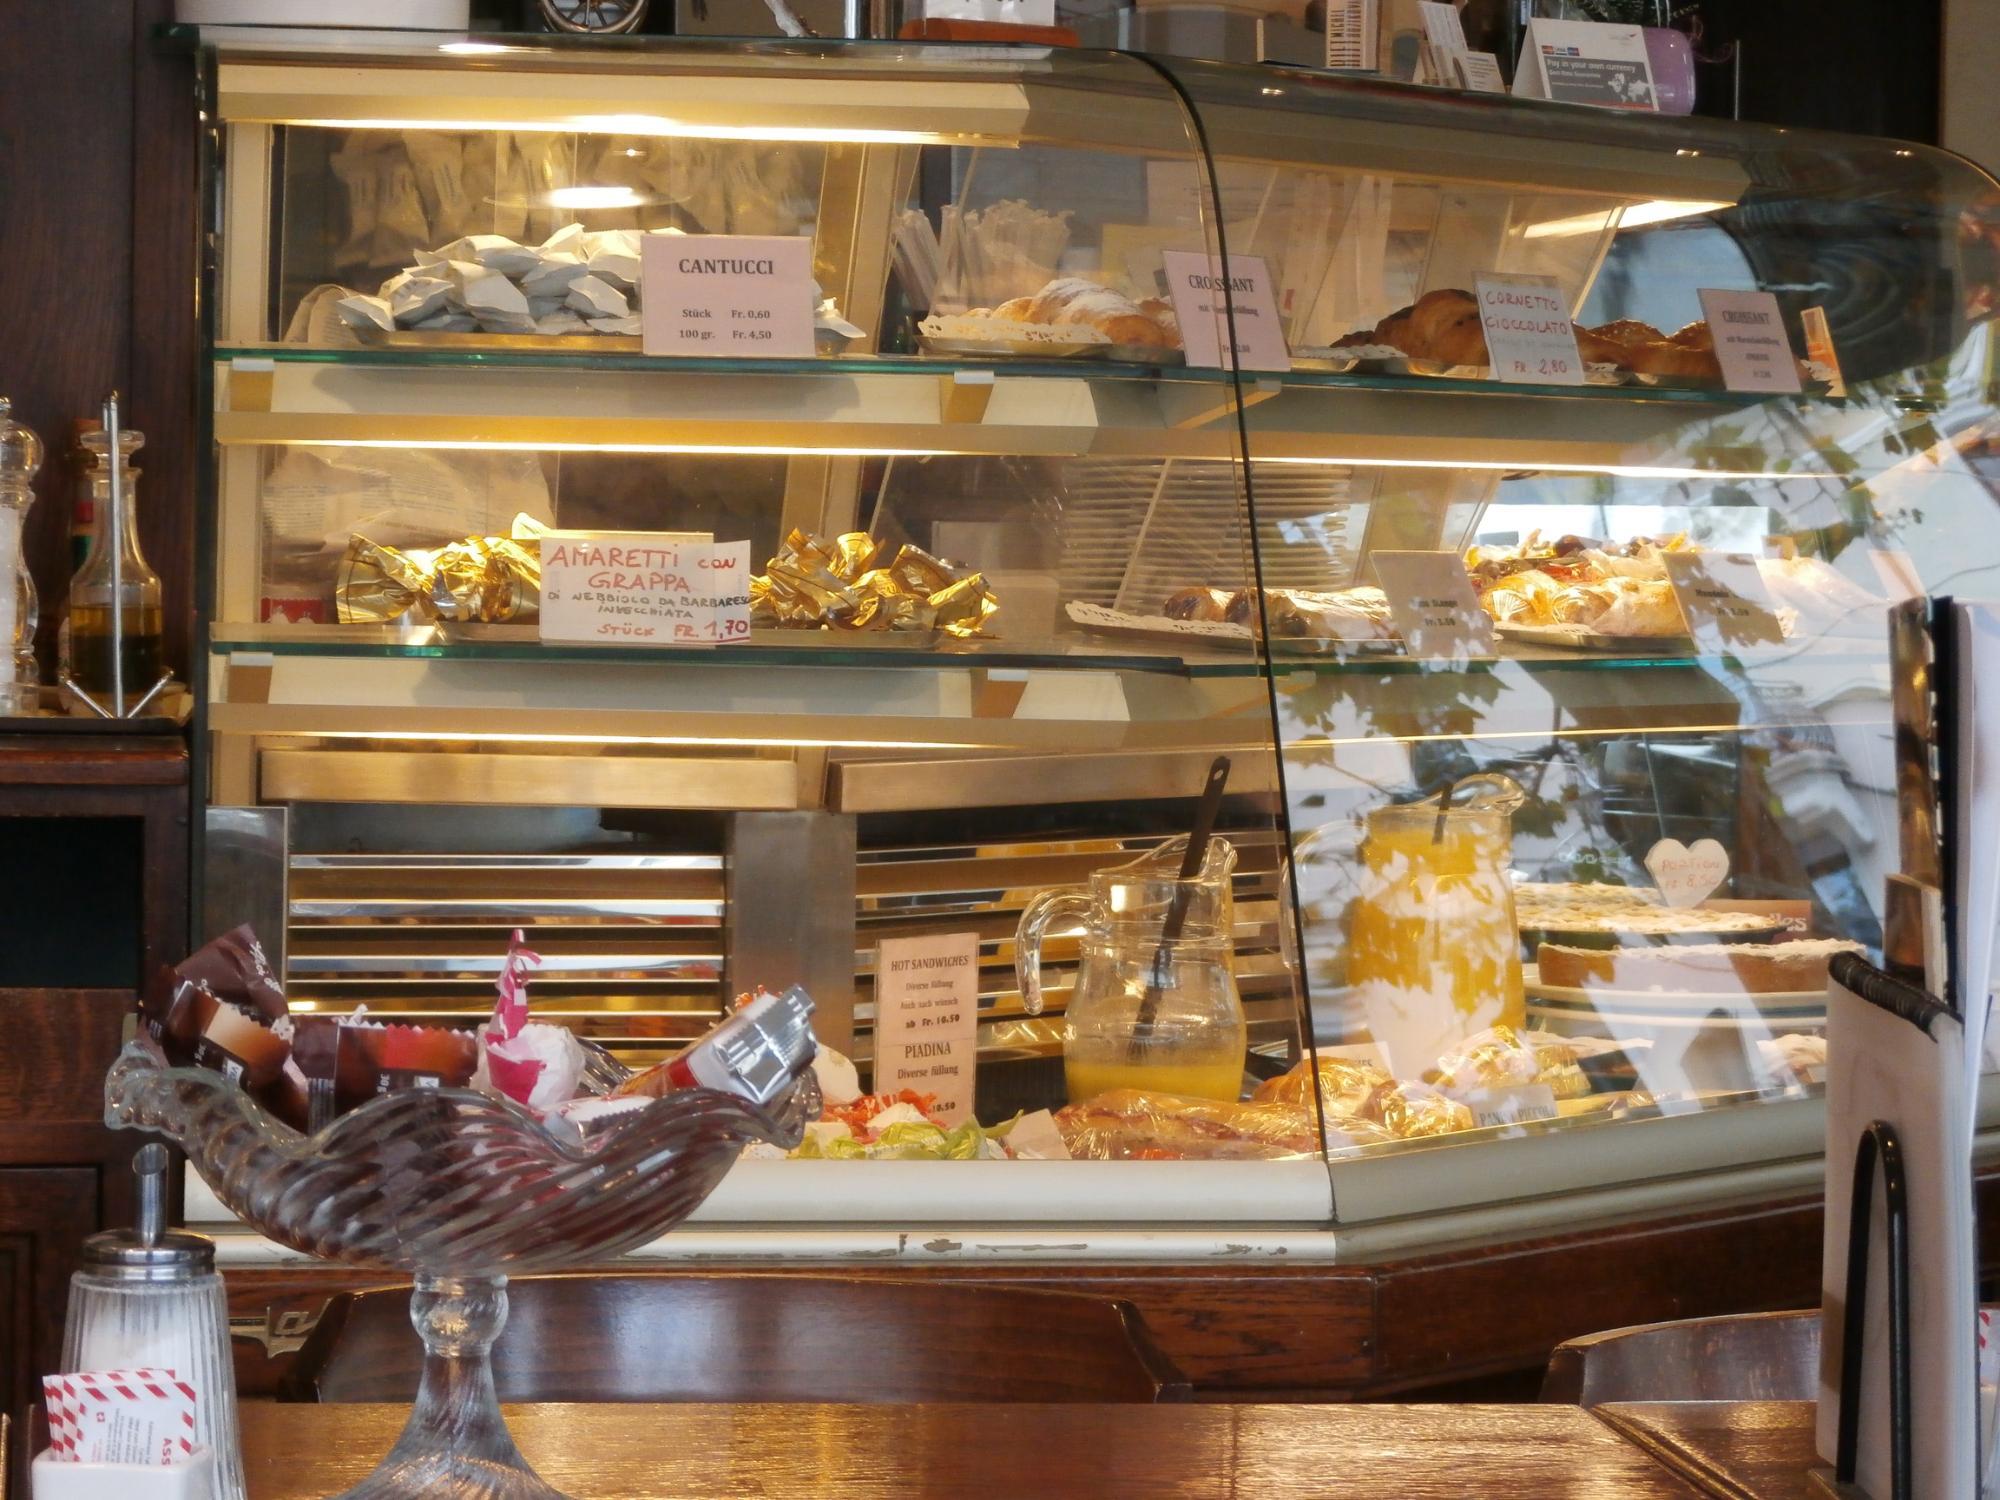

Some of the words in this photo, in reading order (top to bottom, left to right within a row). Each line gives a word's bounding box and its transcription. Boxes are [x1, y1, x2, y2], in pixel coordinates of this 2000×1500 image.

[1547, 59, 1560, 68] Pay
[1570, 61, 1587, 70] your
[1605, 64, 1636, 73] currency
[678, 258, 774, 275] CANTUCCI
[1188, 274, 1255, 293] CROSANT
[1486, 291, 1560, 311] CORNETTO
[682, 308, 712, 318] Stück
[731, 309, 746, 319] Fr.
[747, 310, 770, 320] 0,60
[1485, 316, 1568, 335] CIOCCOLATO
[679, 329, 699, 339] 100
[701, 330, 716, 341] gr.
[732, 329, 747, 340] Fr.
[748, 330, 772, 340] 4,50
[588, 571, 692, 593] GRAPPA
[658, 596, 676, 606] DA
[596, 622, 656, 636] STÜCK
[673, 624, 700, 638] FR.
[703, 619, 749, 640] 1,70
[891, 959, 910, 971] HOT
[911, 954, 970, 970] SANDWICHES
[905, 982, 930, 992] Diverse
[904, 1041, 952, 1060] PIADINA
[897, 1067, 929, 1080] Diverse
